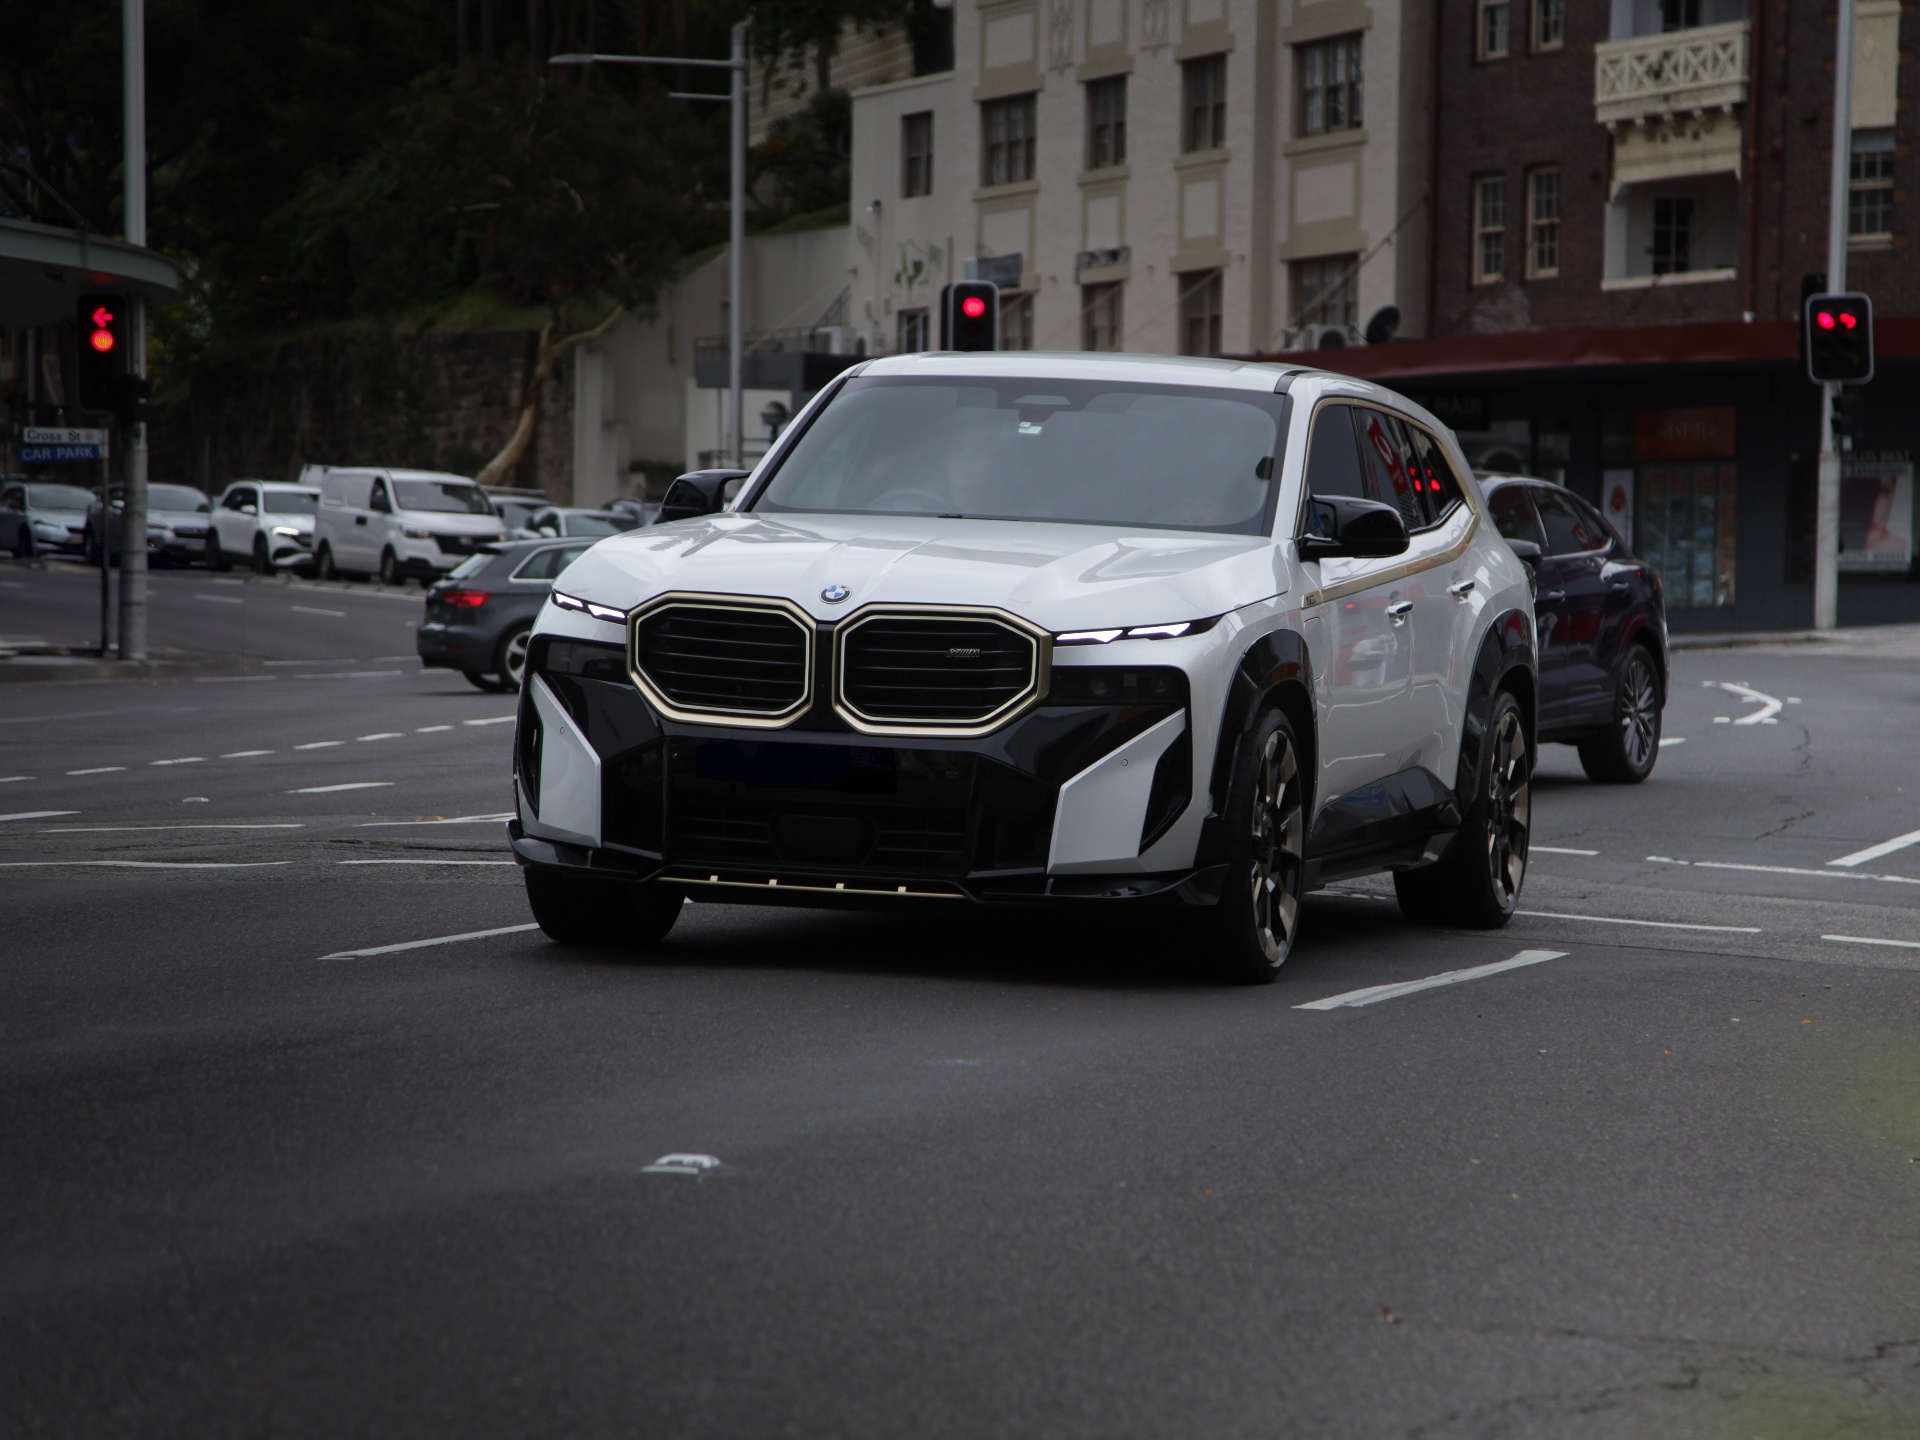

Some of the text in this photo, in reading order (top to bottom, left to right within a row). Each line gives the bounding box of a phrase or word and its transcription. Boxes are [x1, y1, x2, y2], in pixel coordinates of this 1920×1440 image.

[1434, 396, 1482, 415] HAIR
[27, 429, 81, 441] Cross St
[22, 446, 94, 461] CAR PARK
